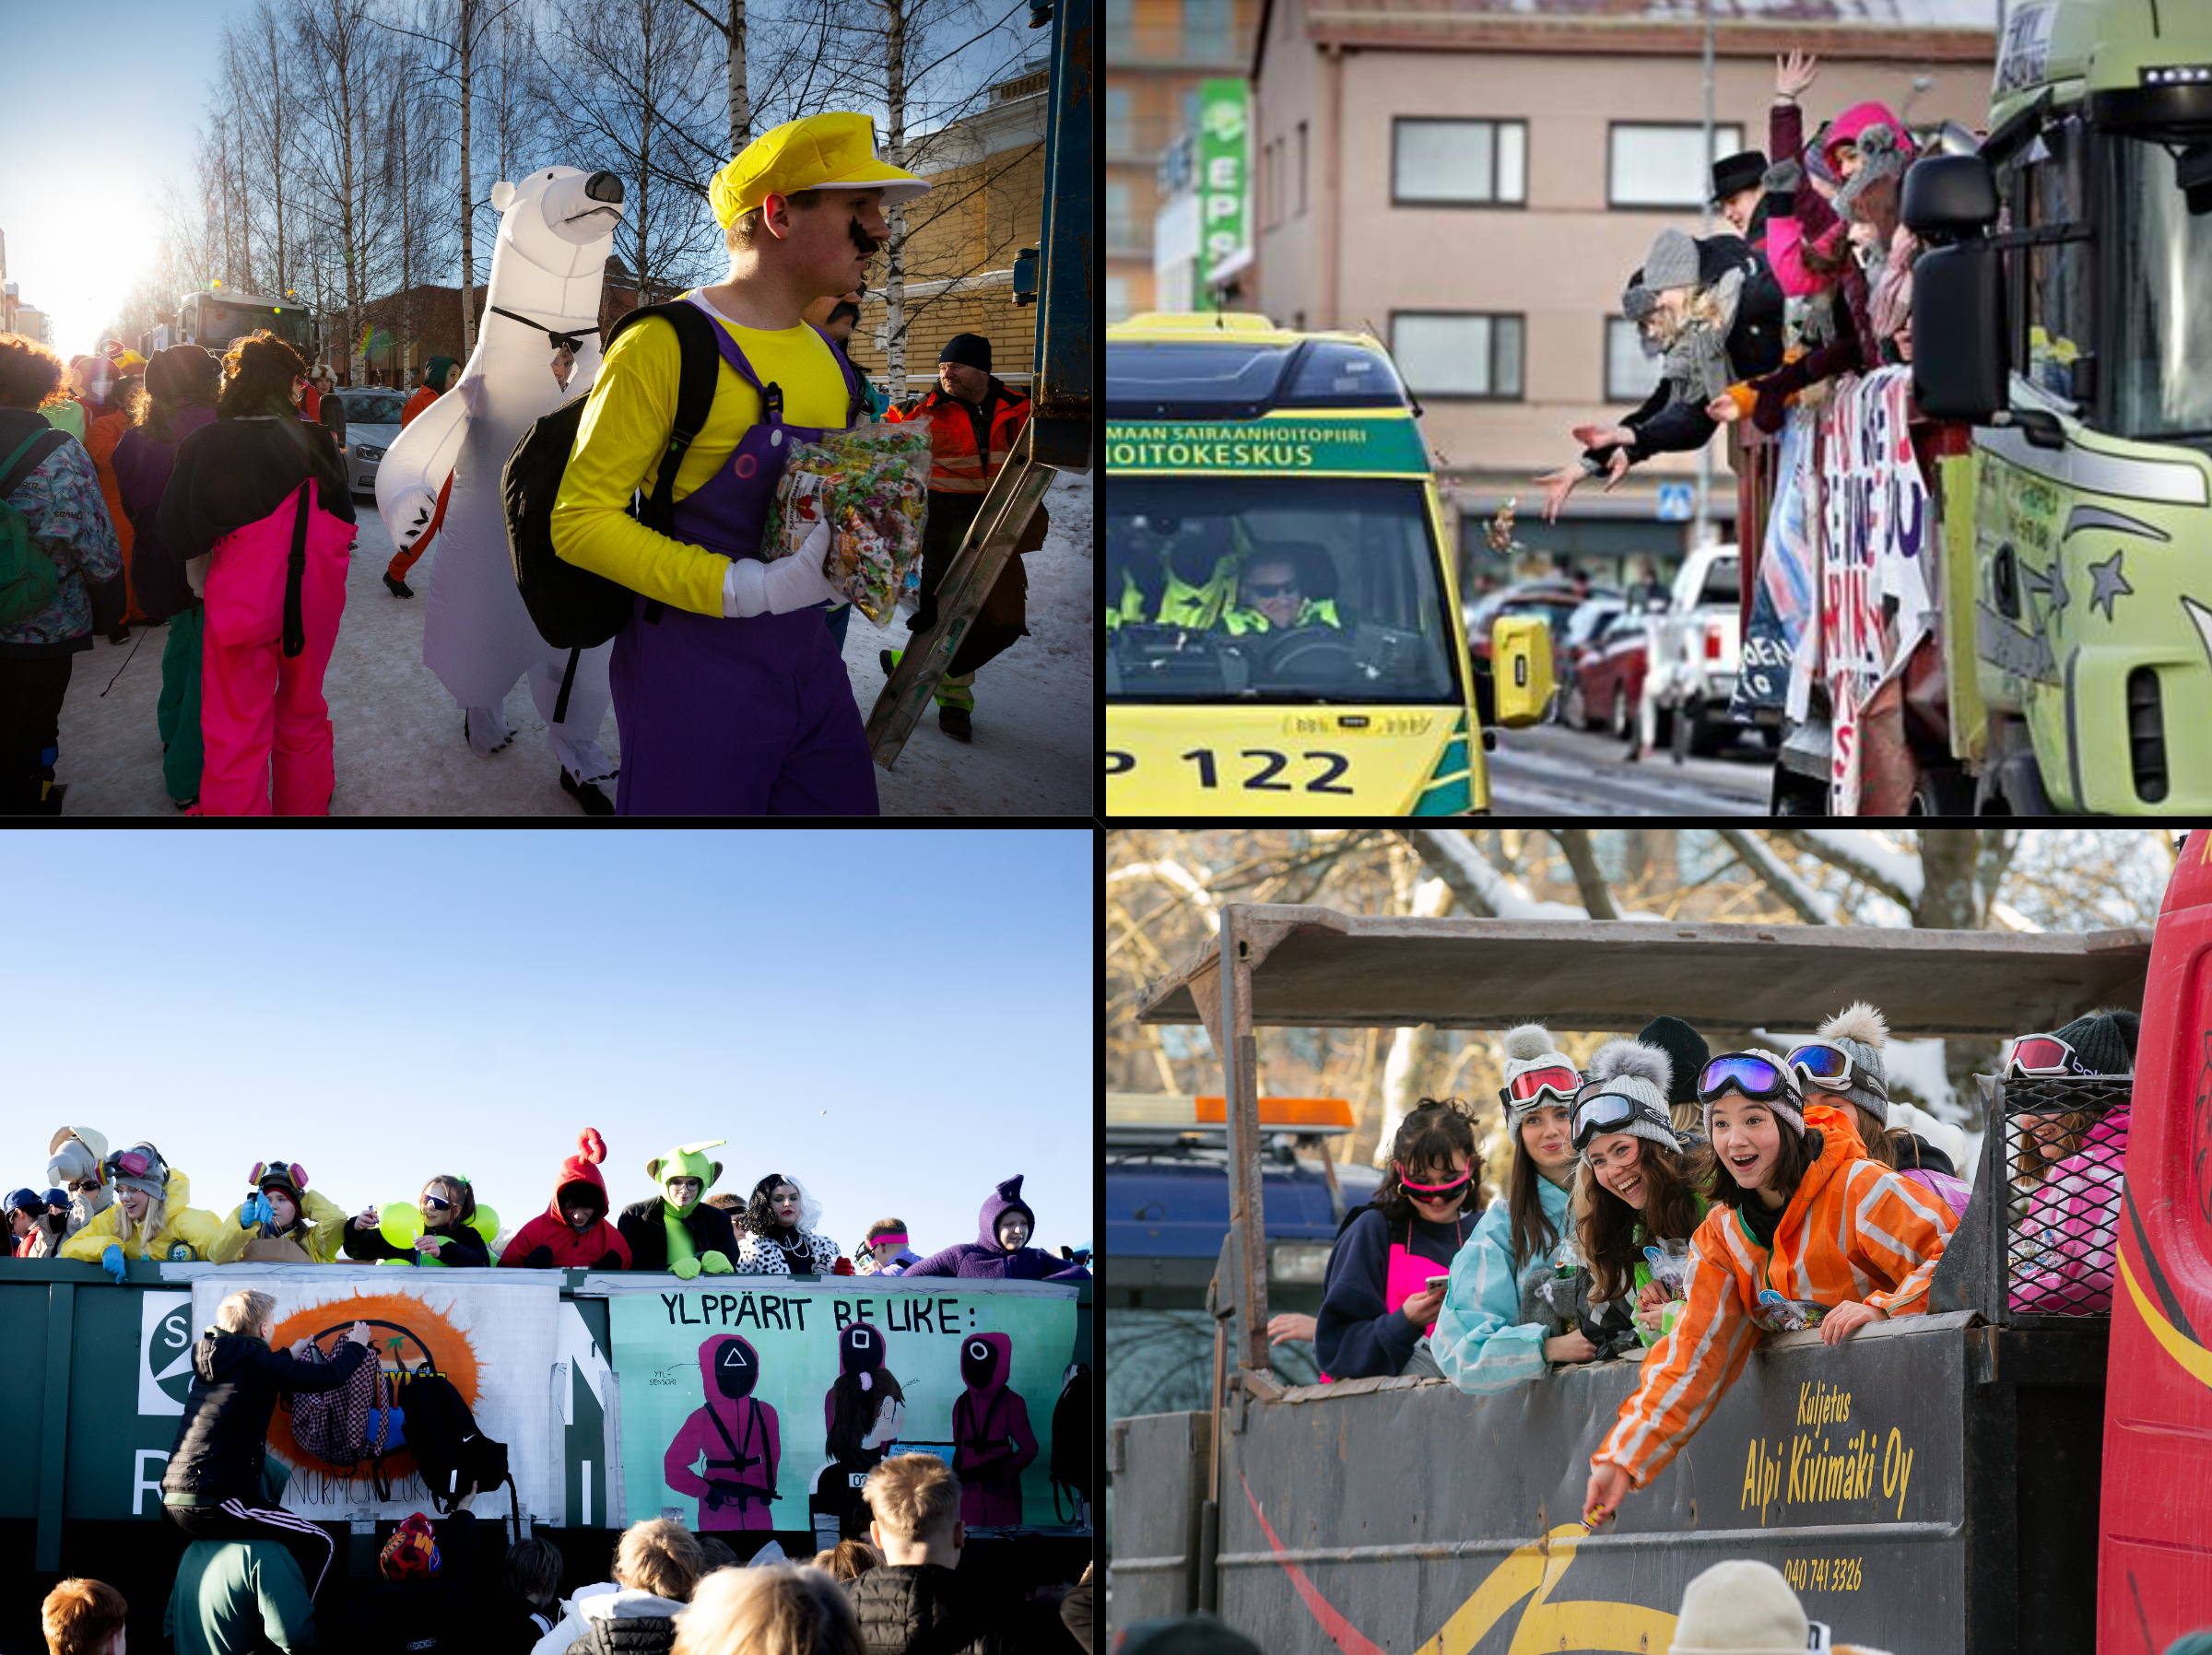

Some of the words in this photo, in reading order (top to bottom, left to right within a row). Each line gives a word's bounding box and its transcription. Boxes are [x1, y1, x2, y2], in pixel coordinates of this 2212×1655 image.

[1171, 427, 1367, 443] SAIRAANHOITOPIIRI
[1182, 749, 1355, 795] 122
[661, 1290, 813, 1332] YLPPÄRIT
[1797, 1379, 1851, 1438] Kuljetus
[1741, 1438, 1783, 1527] Alpi
[1787, 1428, 1877, 1504] Kivimäki
[1882, 1426, 1914, 1520] Oy
[1783, 1557, 1807, 1592] 040
[1809, 1557, 1830, 1592] 741
[1830, 1556, 1863, 1592] 3326
